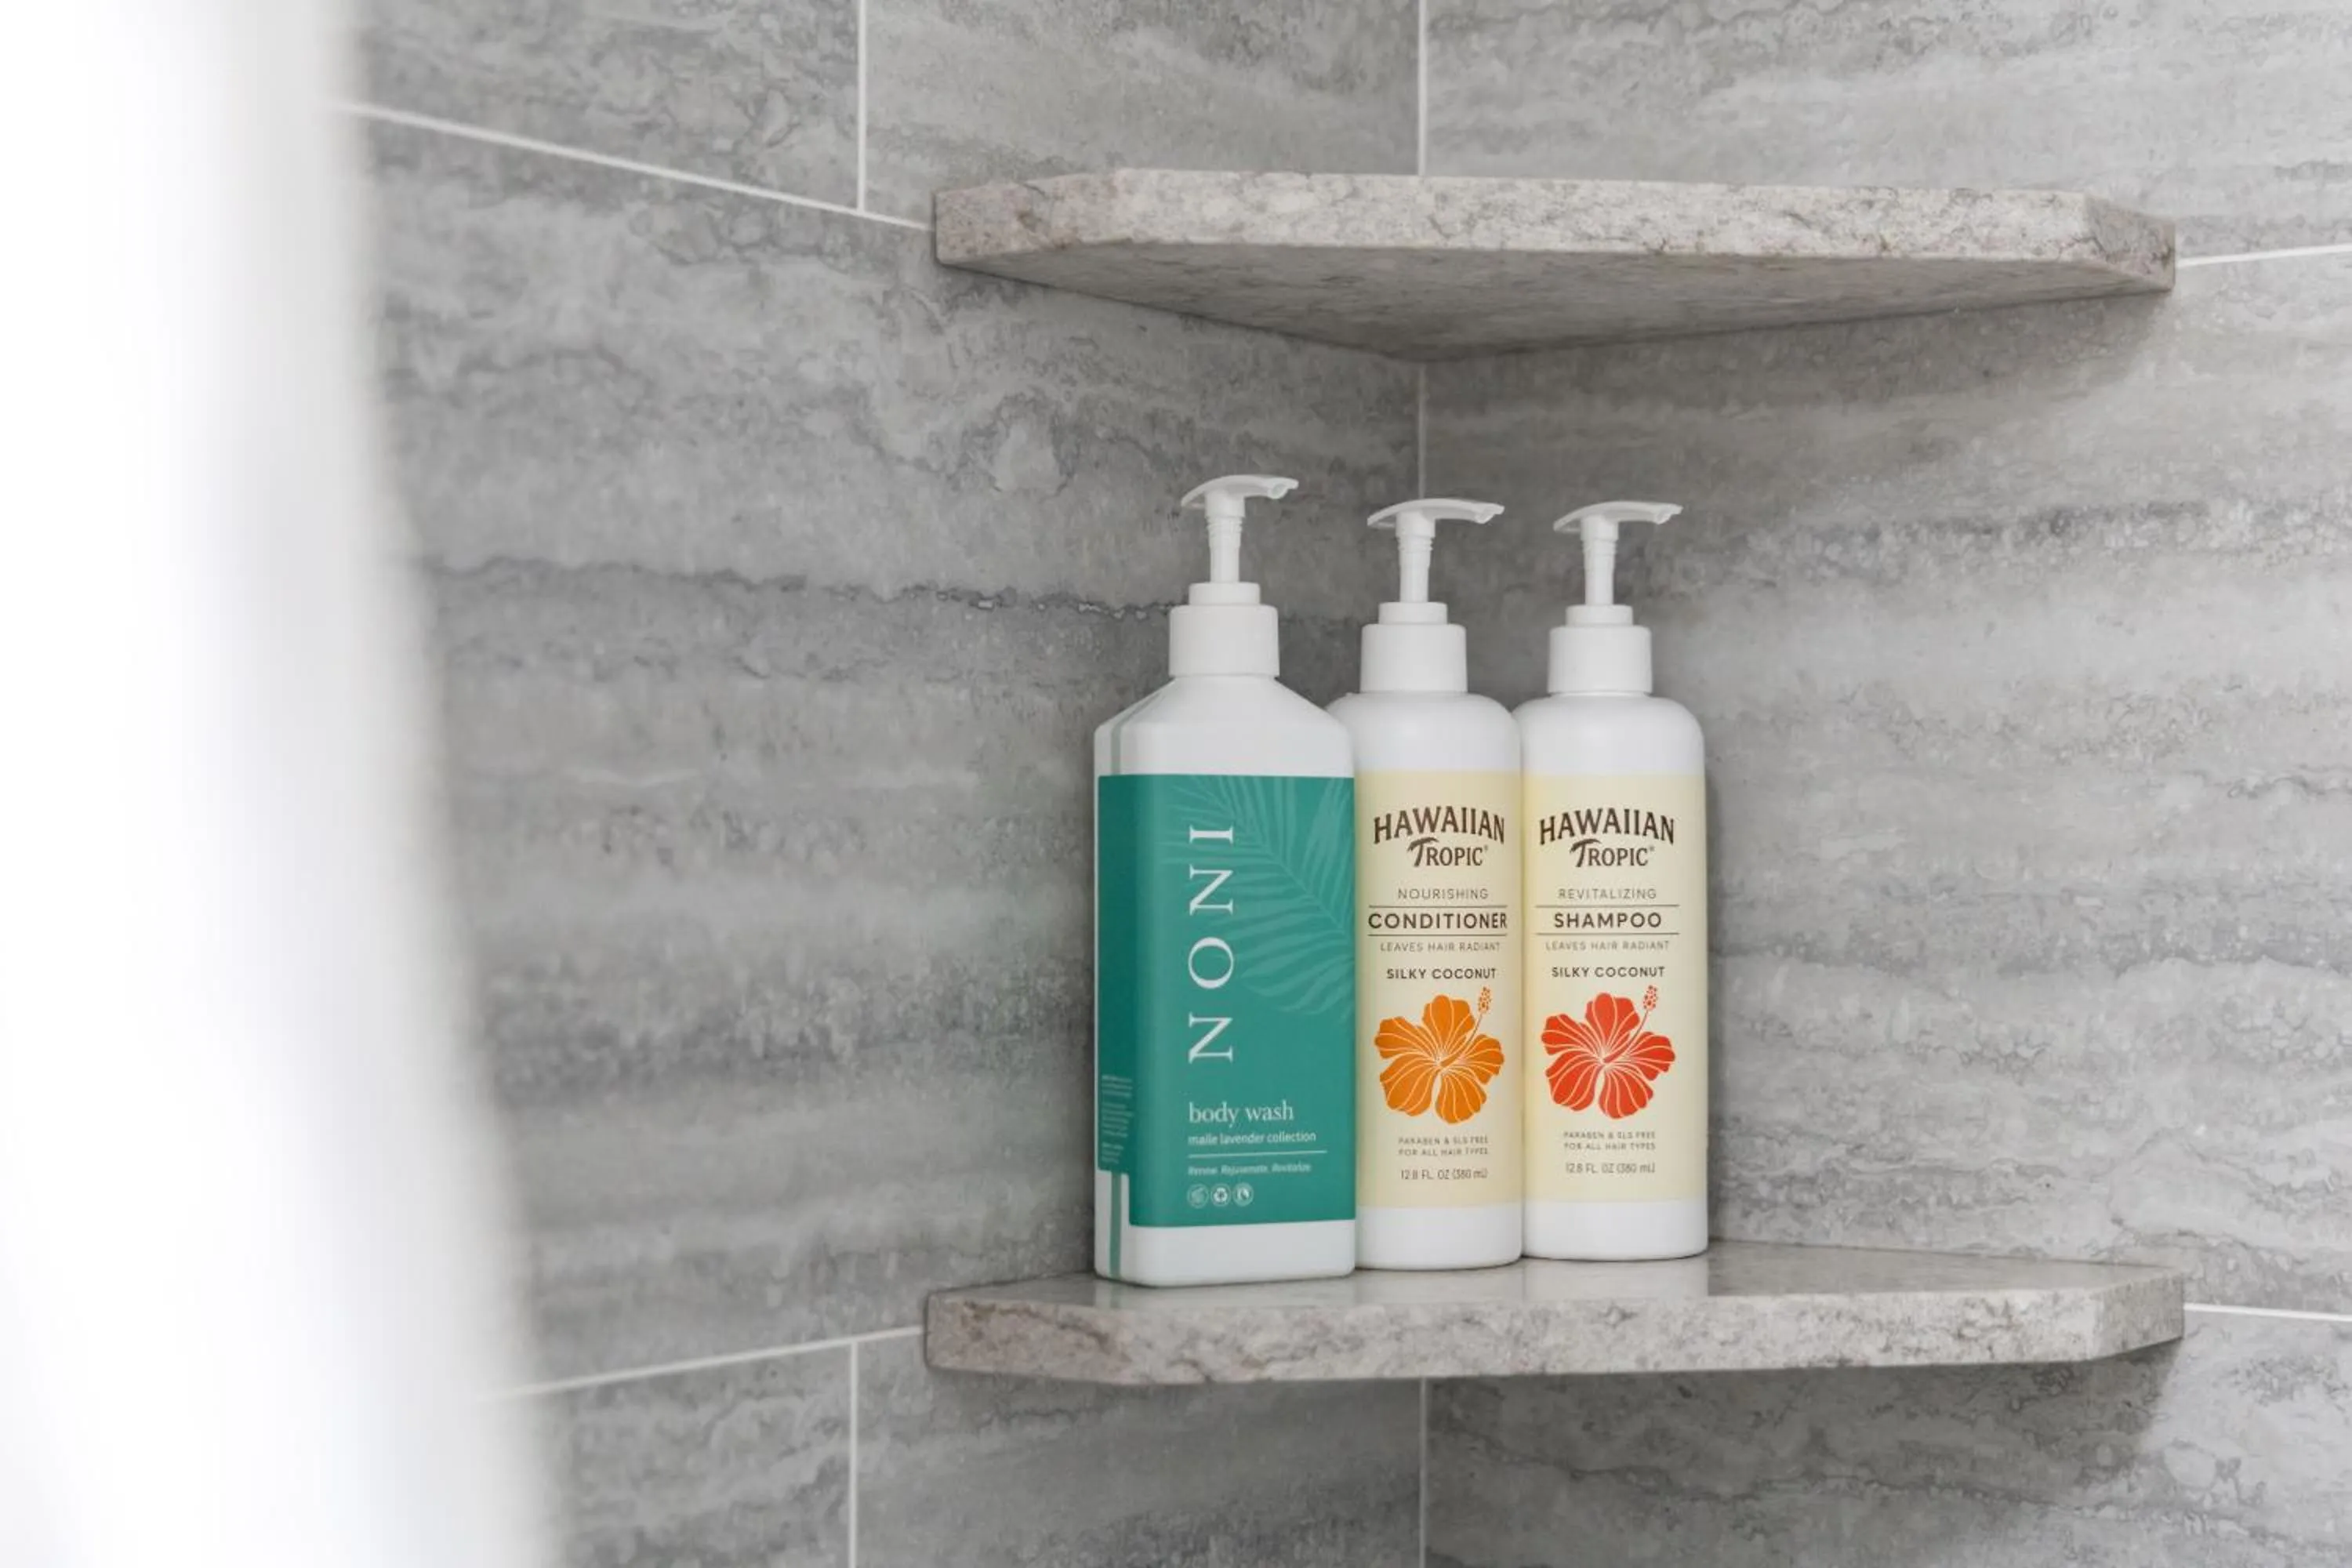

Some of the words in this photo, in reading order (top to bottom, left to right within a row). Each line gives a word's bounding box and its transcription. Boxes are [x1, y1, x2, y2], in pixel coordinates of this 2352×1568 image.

[1374, 806, 1504, 844] HAWAIIAN
[1539, 808, 1675, 845] HAWAIIAN
[1398, 888, 1489, 900] NOURISHING
[1558, 888, 1657, 899] REVITALIZING
[1368, 913, 1507, 929] CONDITIONER
[1554, 913, 1662, 928] SHAMPOO
[1188, 825, 1234, 1064] NONI
[1381, 942, 1423, 952] LEAVES
[1428, 942, 1454, 952] HAIR
[1460, 942, 1501, 951] RADIANT
[1545, 942, 1586, 951] LEAVES
[1591, 941, 1618, 950] HAIR
[1622, 940, 1669, 950] RADIANT
[1386, 968, 1427, 979] SILKY
[1432, 968, 1496, 979] COCONUT
[1552, 967, 1589, 978] SILKY
[1595, 967, 1665, 978] COCONUT
[1189, 1101, 1239, 1127] body
[1245, 1099, 1294, 1121] wash
[1220, 1132, 1265, 1145] lavender
[1267, 1130, 1317, 1143] collection
